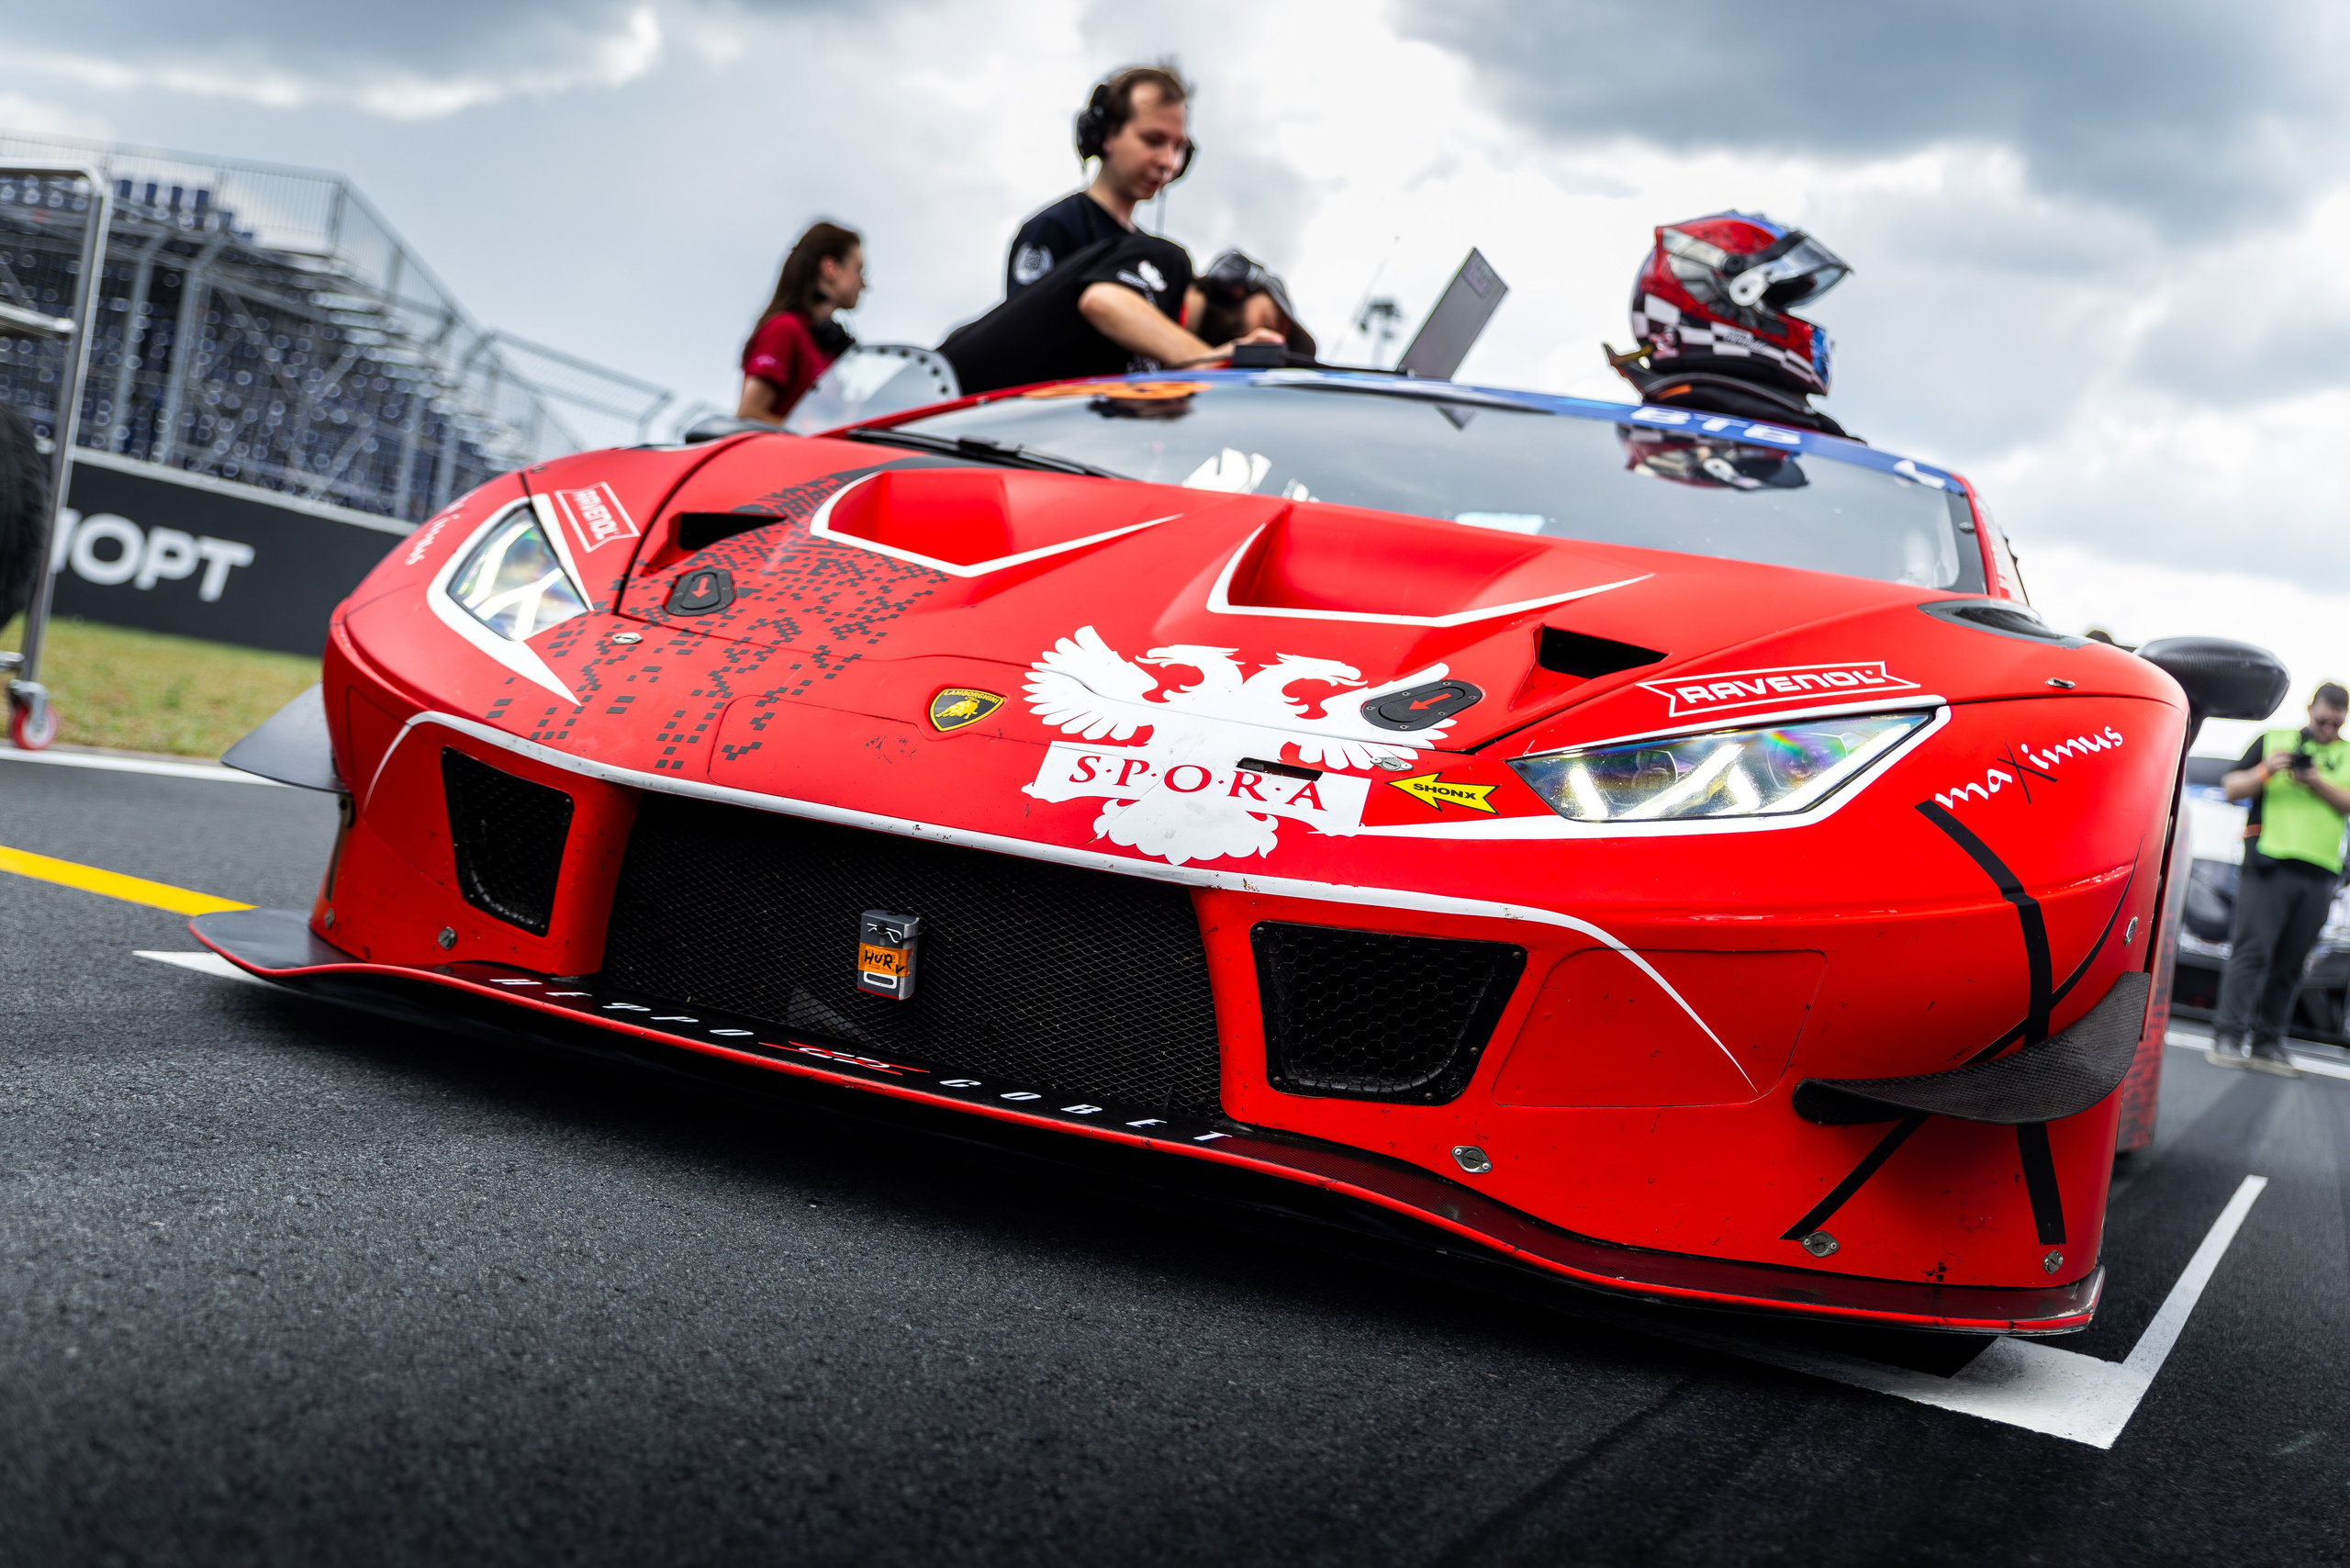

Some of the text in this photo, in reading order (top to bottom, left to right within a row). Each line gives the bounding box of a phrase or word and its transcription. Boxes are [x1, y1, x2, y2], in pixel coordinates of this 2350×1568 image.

[571, 488, 621, 541] RAVENOL
[943, 689, 1000, 704] LAMBORGHINI
[1675, 670, 1885, 704] RAVENOL
[1413, 783, 1477, 801] SHONX
